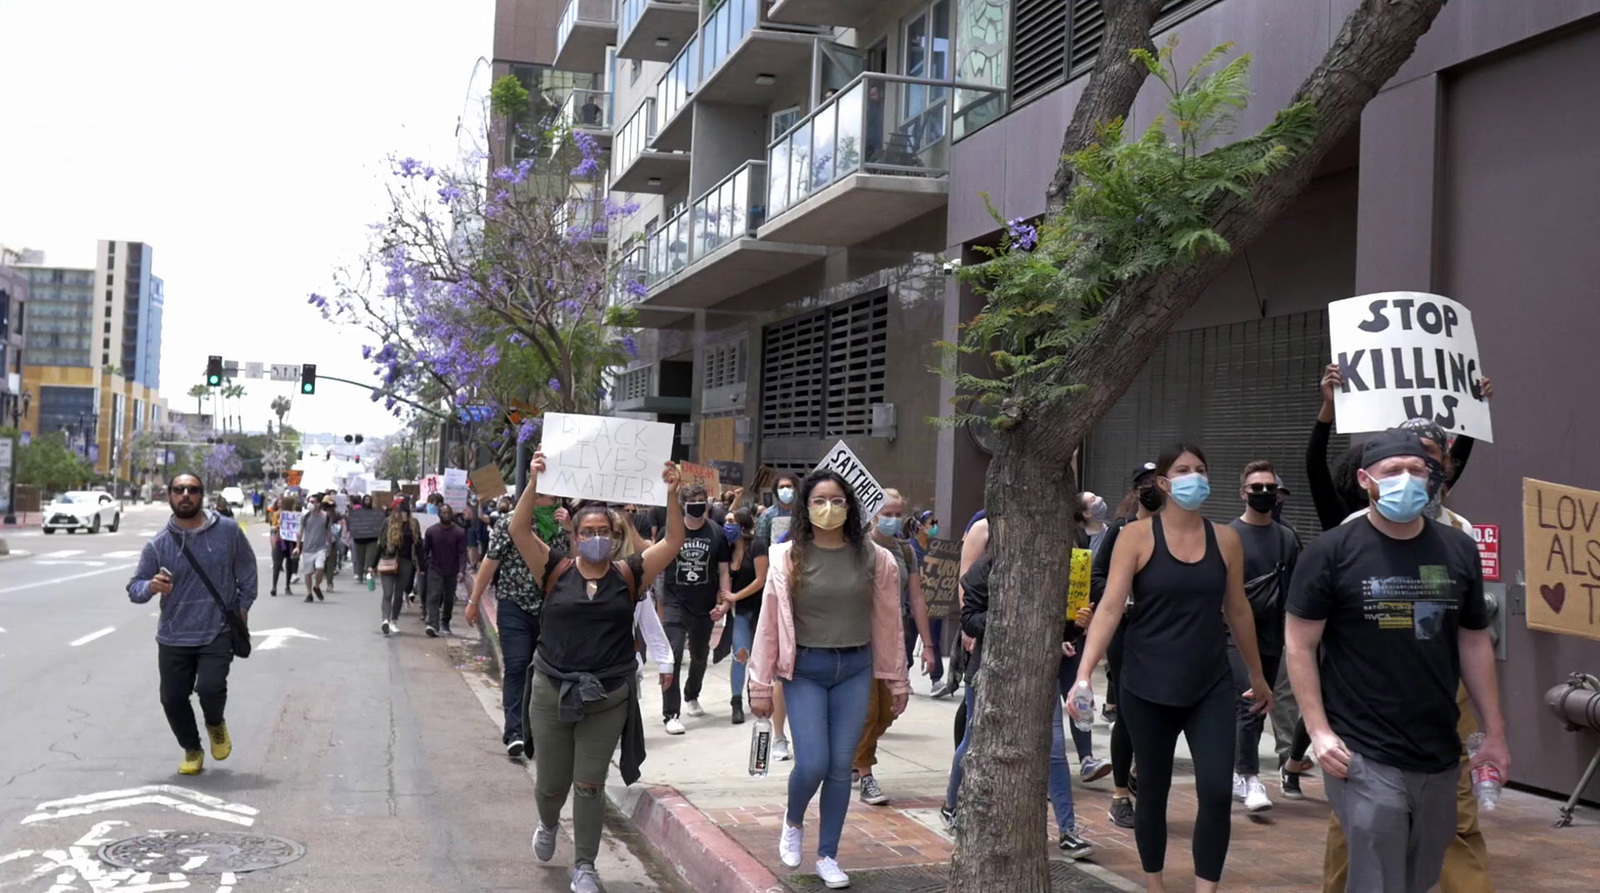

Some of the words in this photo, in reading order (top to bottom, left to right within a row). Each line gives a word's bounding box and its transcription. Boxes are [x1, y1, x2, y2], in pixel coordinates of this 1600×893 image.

[1358, 299, 1458, 338] STOP
[1338, 347, 1483, 402] KILLING
[562, 415, 648, 448] BLACK
[559, 443, 648, 473] LIVES
[551, 471, 656, 501] MATTER
[830, 449, 858, 479] SAY
[851, 468, 884, 513] THEIR
[1364, 613, 1391, 621] RVCA
